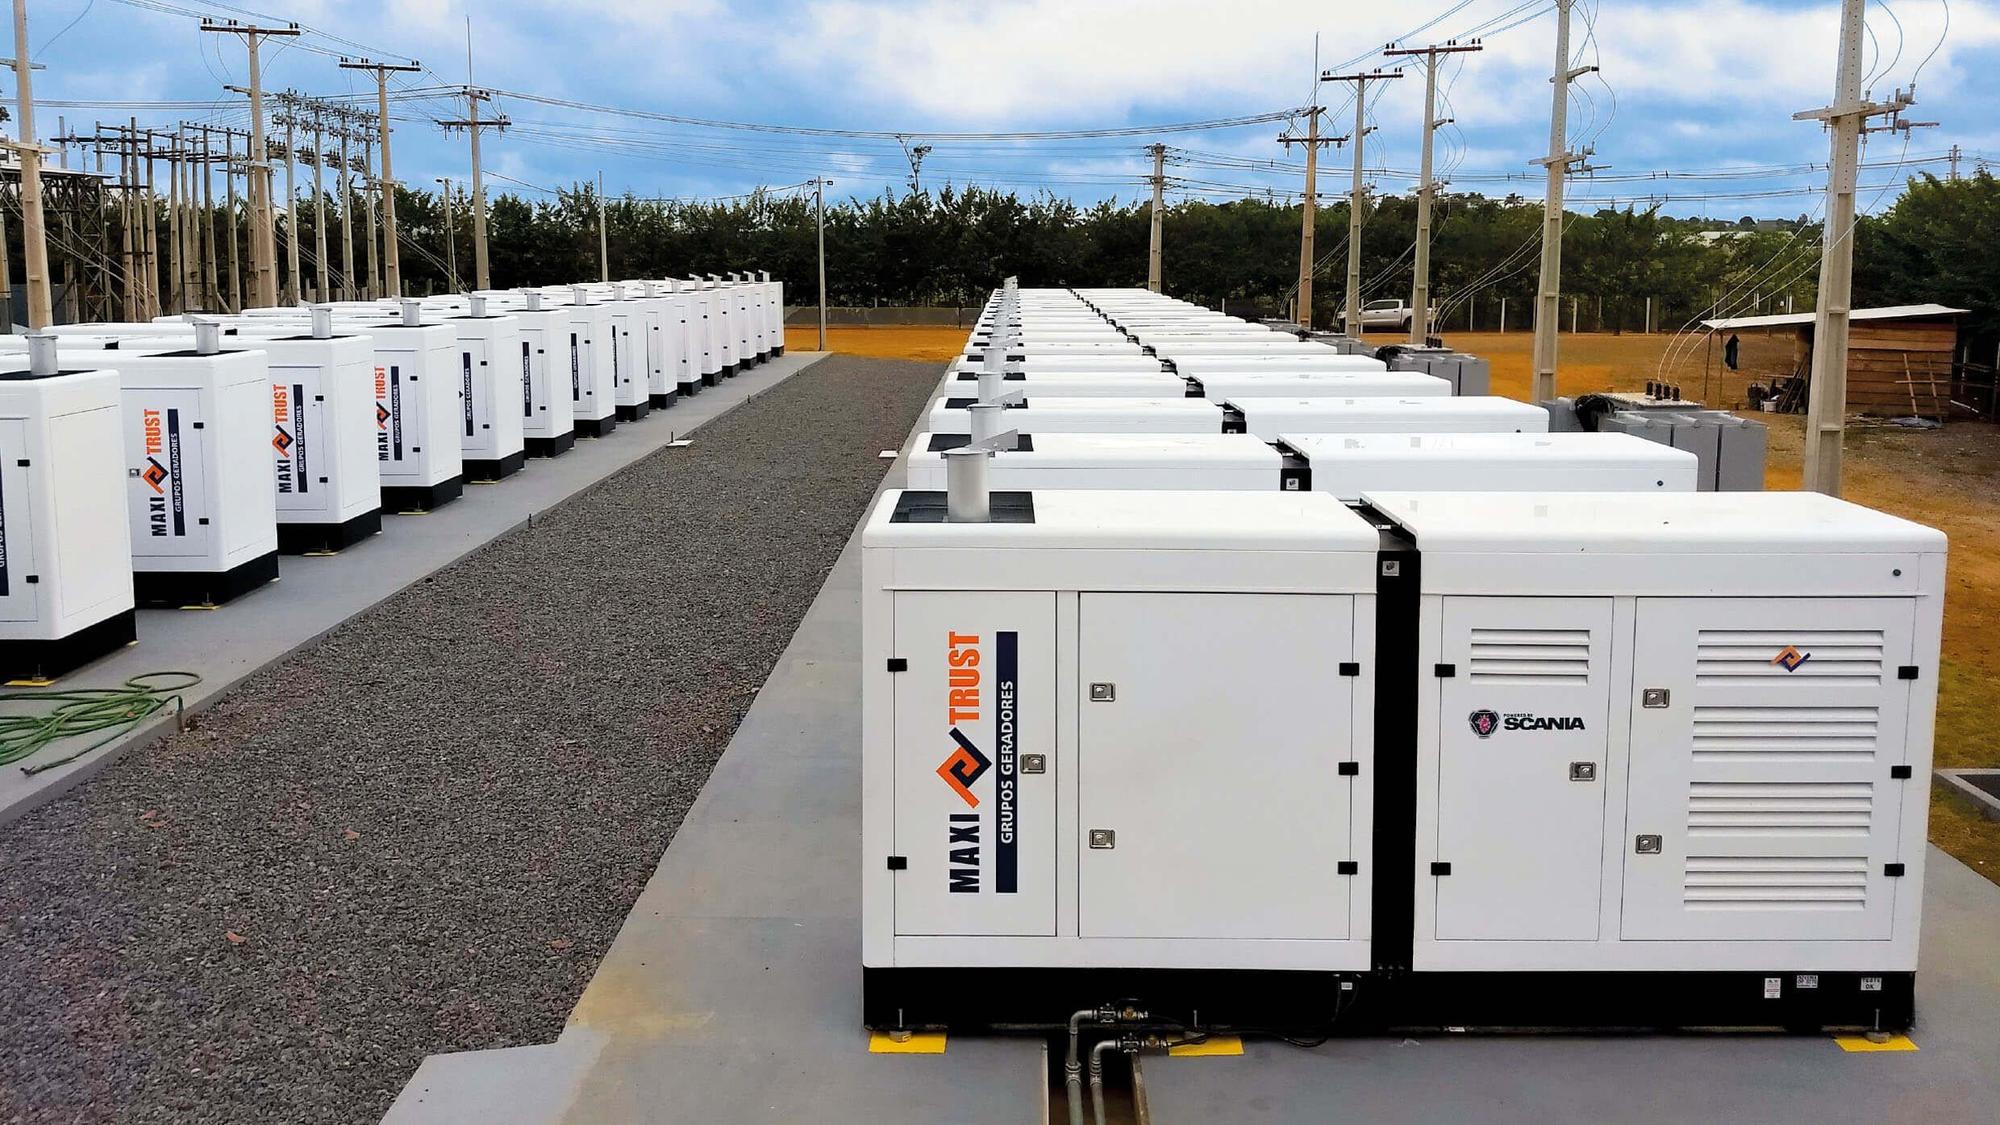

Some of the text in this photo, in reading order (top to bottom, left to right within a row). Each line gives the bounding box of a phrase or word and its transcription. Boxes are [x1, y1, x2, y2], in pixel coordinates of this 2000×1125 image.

[144, 408, 168, 537] MAXI TRUST
[170, 432, 182, 513] GRUPOS GERADORES
[273, 384, 292, 493] MAXI TRUST
[377, 432, 389, 461] MAXI
[948, 631, 980, 893] MAXI TRUST
[1000, 680, 1014, 845] GRUPOS GERADORES
[1504, 717, 1585, 730] SCANIA
